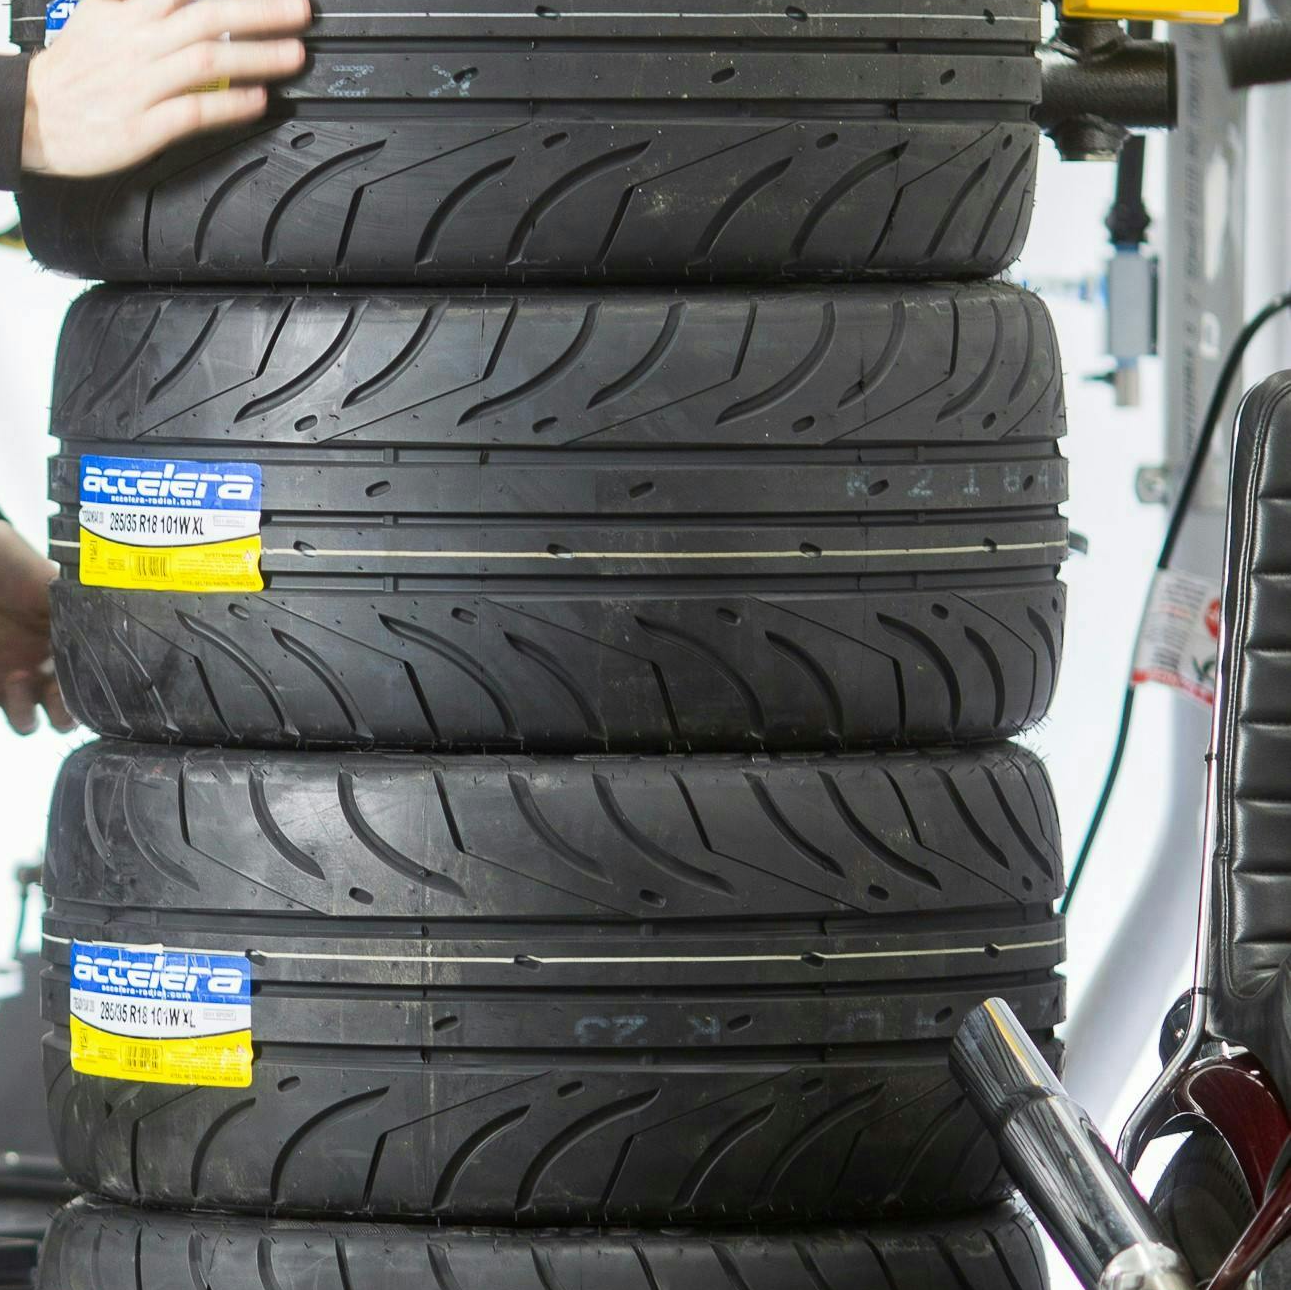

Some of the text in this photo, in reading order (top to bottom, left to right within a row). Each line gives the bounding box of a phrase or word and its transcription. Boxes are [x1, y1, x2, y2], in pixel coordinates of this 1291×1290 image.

[83, 463, 254, 500] accelera
[109, 512, 137, 532] 285/35
[139, 514, 158, 534] R18
[162, 515, 190, 535] 101W
[192, 516, 204, 535] XL
[73, 955, 243, 994] accelera
[100, 1001, 127, 1022] 285/35
[182, 1007, 196, 1028] XL
